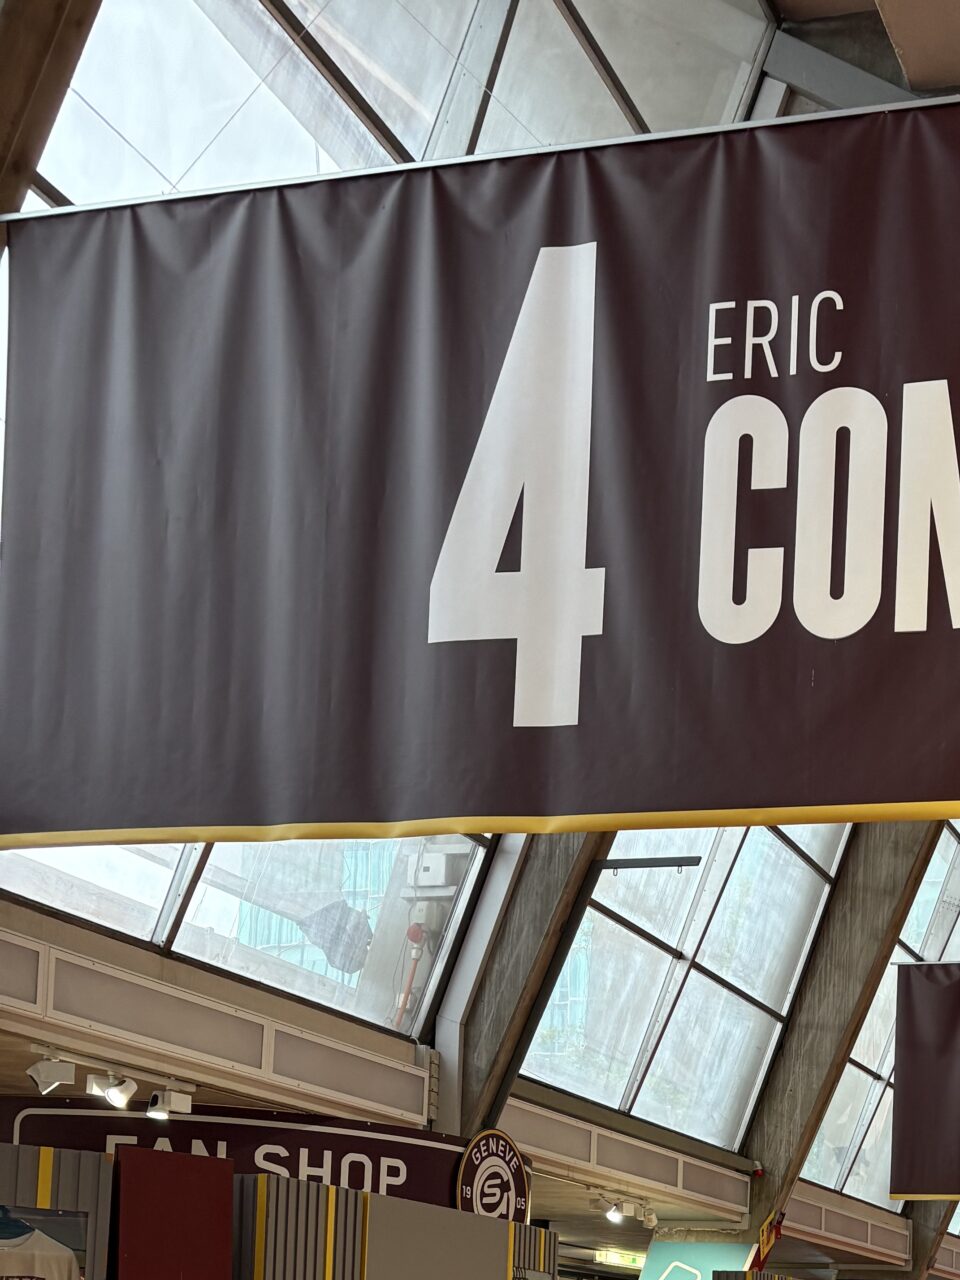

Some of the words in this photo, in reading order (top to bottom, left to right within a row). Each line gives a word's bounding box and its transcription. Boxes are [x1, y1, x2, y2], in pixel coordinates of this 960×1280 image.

[706, 290, 844, 383] ERIC
[428, 242, 605, 727] 4
[254, 1144, 407, 1195] SHOP
[472, 1138, 519, 1173] GENEVE
[462, 1185, 471, 1198] 19
[516, 1197, 525, 1209] 05
